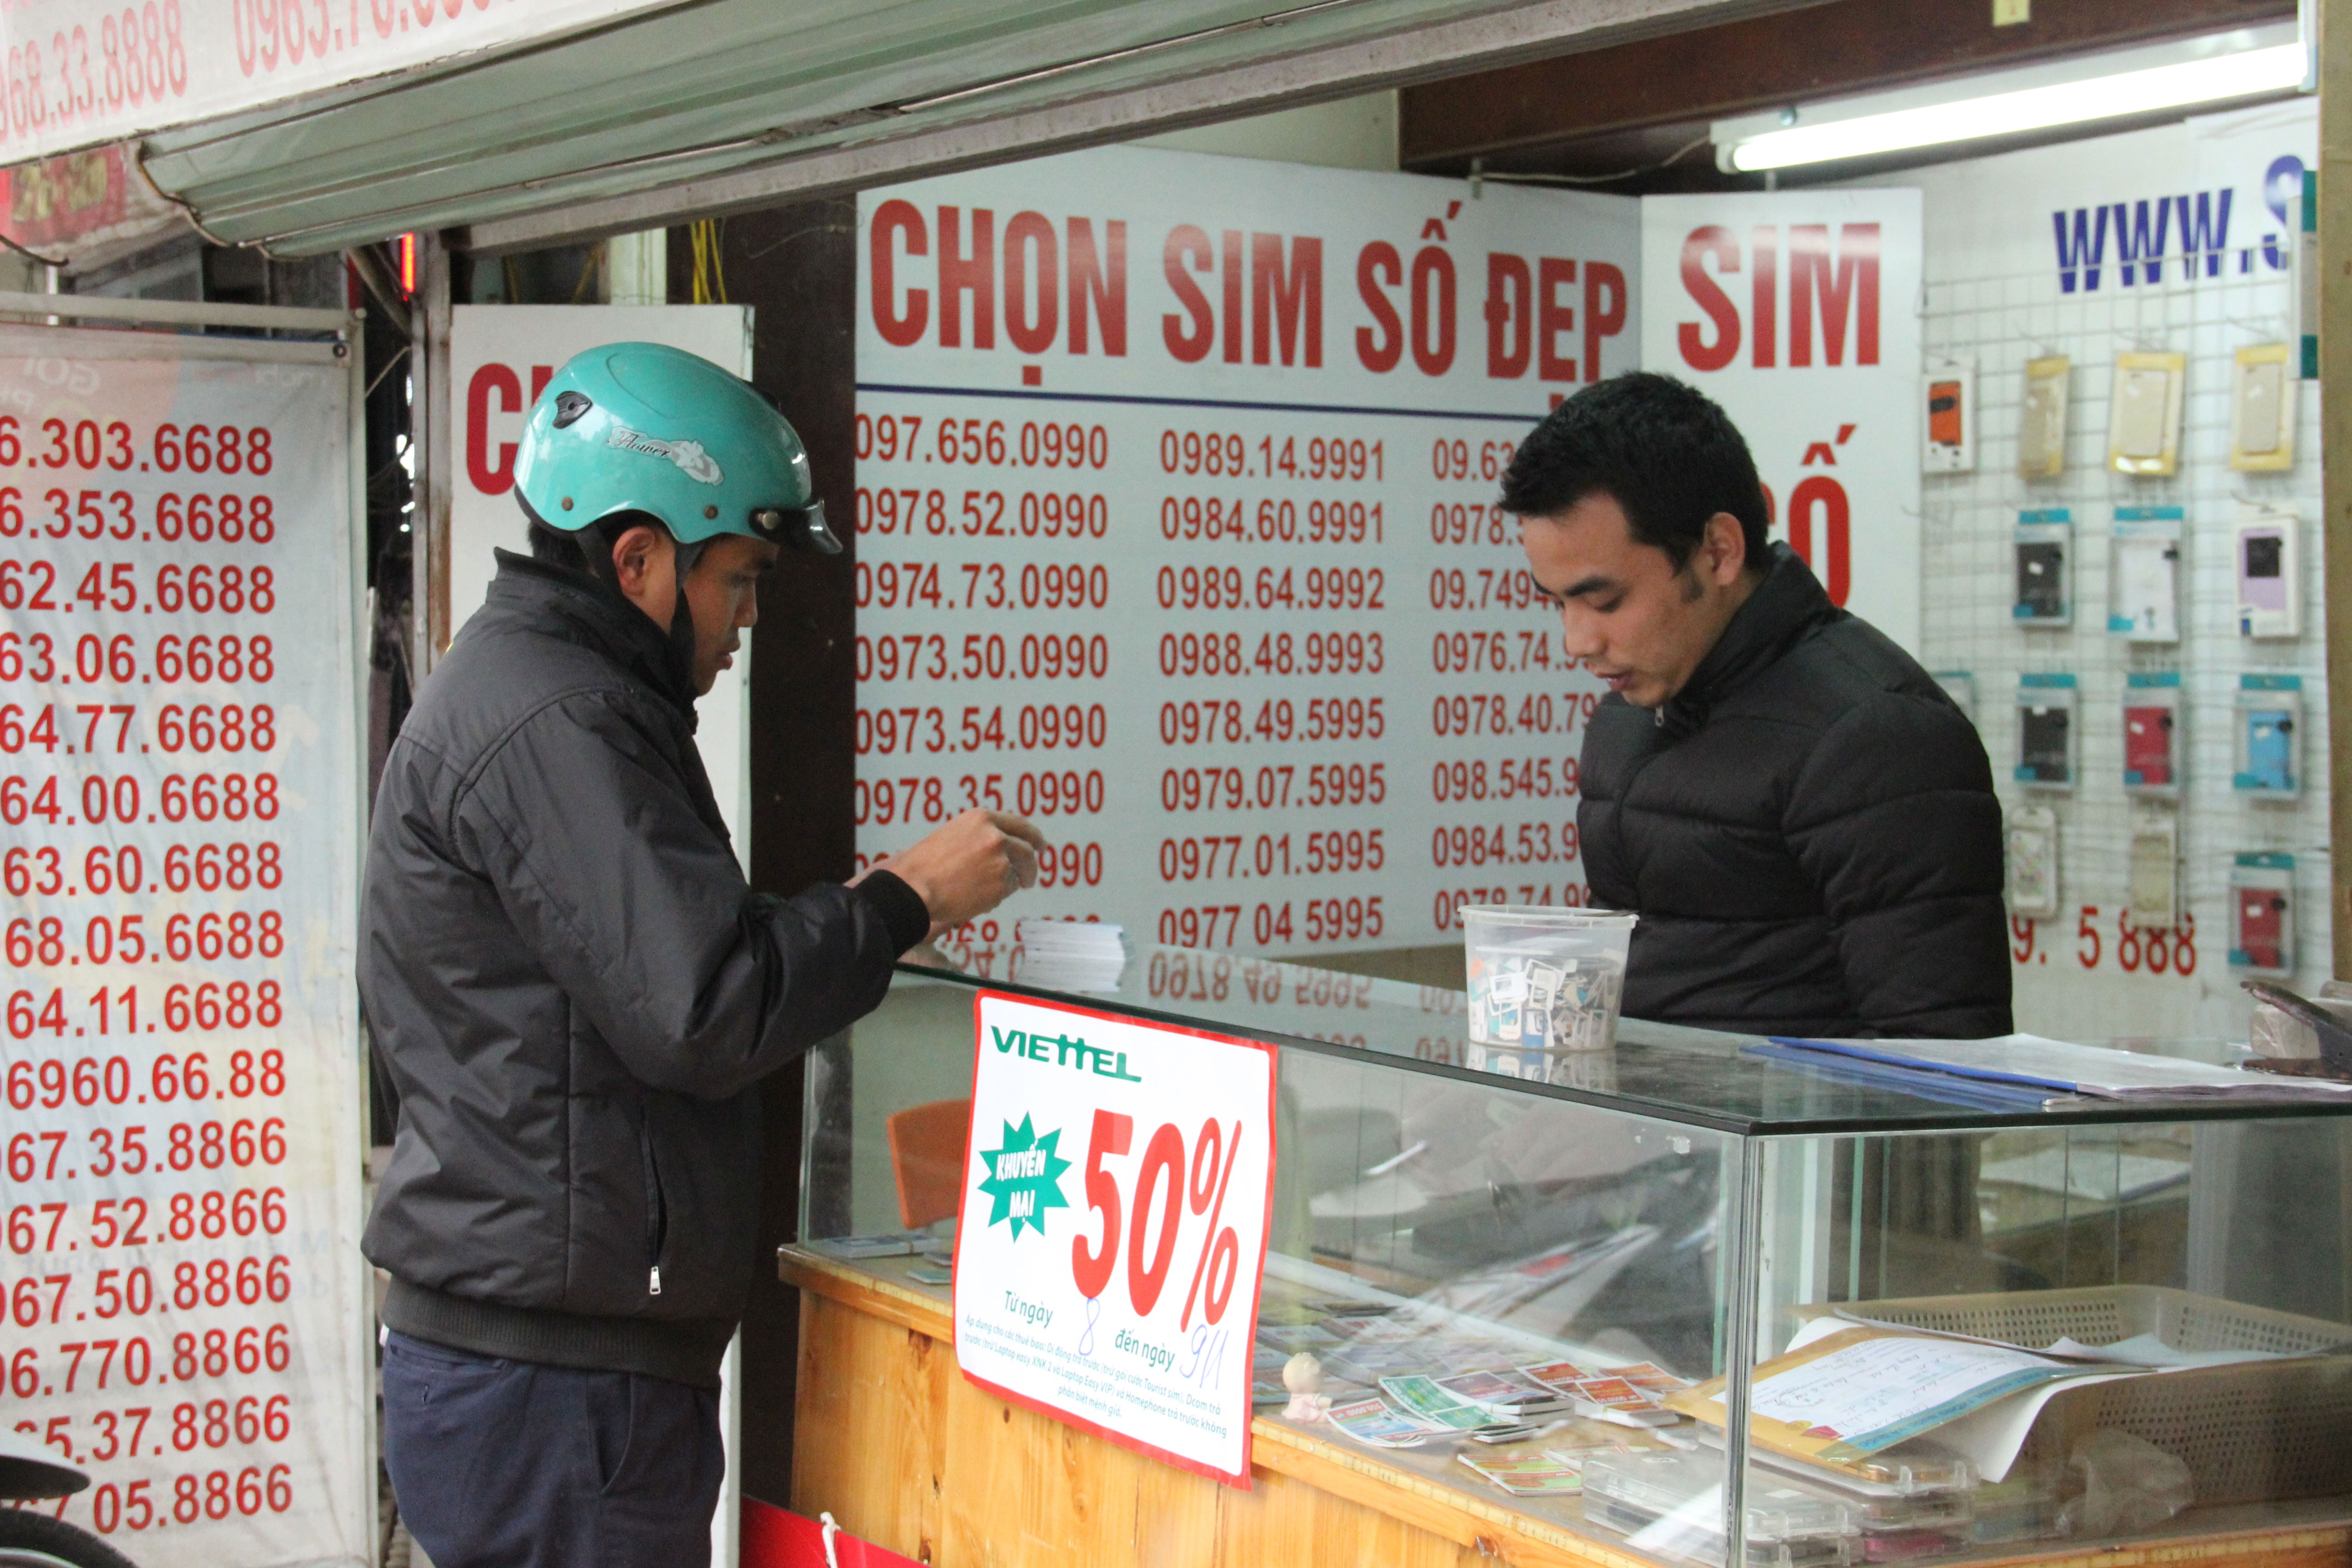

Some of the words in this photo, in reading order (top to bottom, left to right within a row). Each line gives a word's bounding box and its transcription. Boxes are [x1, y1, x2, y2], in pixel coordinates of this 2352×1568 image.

[870, 198, 1127, 386] CHỌN
[1162, 225, 1323, 368] SIM
[1356, 201, 1462, 377] SỐ
[1484, 252, 1627, 409] ĐẸP
[1678, 222, 1881, 371] SIM
[0, 416, 272, 475] 6.303.6688
[466, 362, 553, 496] C
[856, 414, 1107, 469] 097.656.0990
[1162, 431, 1381, 480] 0989.14.9991
[0, 487, 274, 544] 6.353.6688
[856, 489, 1107, 538] 0978.52.0990
[1162, 498, 1381, 542] 0984.60.9991
[1762, 424, 1857, 608] Ố
[0, 560, 275, 613] 62.45.6688
[856, 563, 1107, 608] 0974.73.0990
[1159, 566, 1383, 609] 0989.64.9992
[0, 632, 274, 684] 63.06.6688
[856, 635, 1107, 681] 0973.50.0990
[1161, 633, 1382, 675] 0988.48.9993
[1433, 631, 1589, 674] 0976.74.
[0, 704, 276, 754] 64.77.6688
[856, 705, 1105, 754] 0973.54.0990
[1161, 699, 1382, 744] 0978.49.5995
[1, 773, 279, 825] 64.00.6688
[856, 770, 1103, 825] 0978.35.0990
[1163, 764, 1384, 811] 0979.07.5995
[1431, 757, 1578, 802] 098.545.9
[5, 842, 282, 896] 63.60.6688
[1161, 830, 1382, 881] 0977.01.5995
[1431, 822, 1578, 867] 0984.53.9
[5, 911, 284, 967] 68.05.6688
[1158, 905, 1242, 948] 0977
[1254, 901, 1293, 945] 04
[1306, 896, 1384, 941] 5995
[7, 980, 282, 1039] 64.11.6688
[996, 1139, 1047, 1181] KHUYẾN
[1010, 1190, 1035, 1223] MẠI
[1072, 1108, 1242, 1333] 50%
[0, 1255, 291, 1328] 67.50.8866
[1005, 1290, 1019, 1314] Từ
[1020, 1301, 1054, 1329] ngày
[1078, 1297, 1100, 1356] 8
[1115, 1328, 1139, 1355] đến
[1142, 1343, 1176, 1373] ngày
[0, 1323, 290, 1398] 6.770.8866
[993, 1325, 1003, 1336] cho
[1030, 1337, 1046, 1351] bao:
[1144, 1378, 1166, 1396] Tourist
[1186, 1394, 1207, 1411] Dcom
[1209, 1403, 1220, 1416] trả
[995, 1343, 1015, 1360] Laptop
[1016, 1353, 1031, 1367] easy
[1032, 1356, 1046, 1369] XNK
[1047, 1362, 1052, 1372] 2
[1061, 1367, 1083, 1385] Laptop
[1084, 1375, 1099, 1392] Easy
[1126, 1391, 1166, 1416] Homephone
[1167, 1408, 1178, 1420] trả
[1201, 1418, 1227, 1439] không
[15, 1394, 290, 1464] 5.37.8866
[14, 1463, 292, 1534] 05.8866
